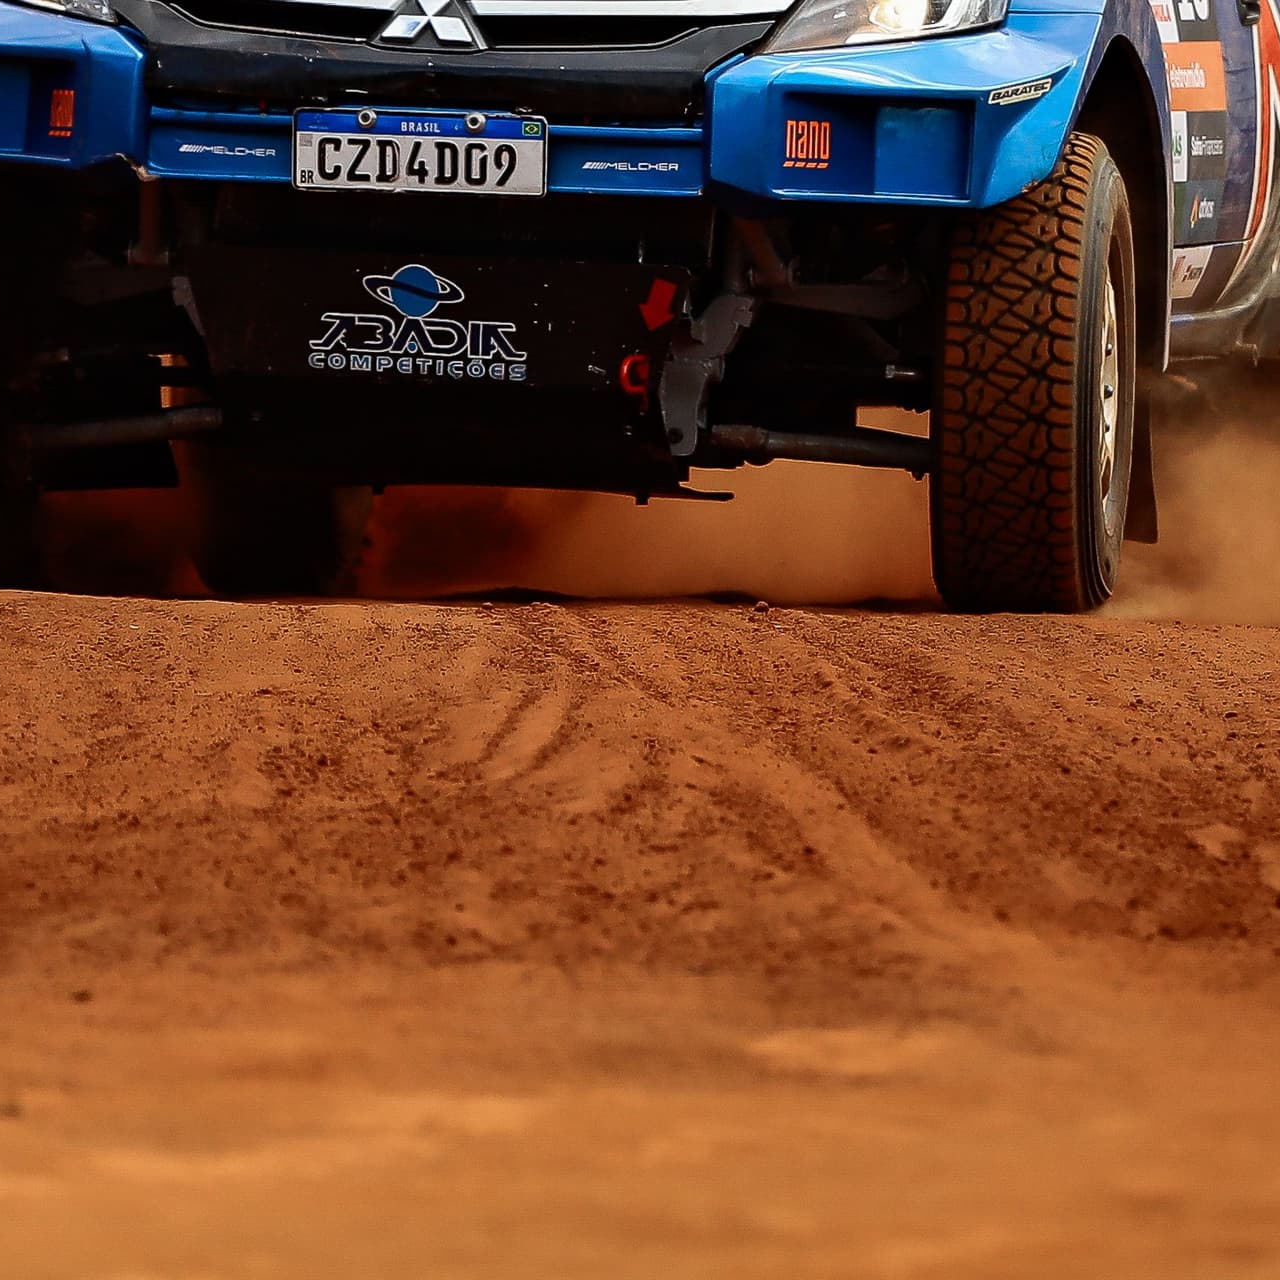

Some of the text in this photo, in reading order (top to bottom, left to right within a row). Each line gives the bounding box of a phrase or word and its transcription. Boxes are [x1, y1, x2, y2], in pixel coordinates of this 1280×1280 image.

[990, 81, 1050, 103] BARATEC
[400, 121, 441, 133] BRASIL
[785, 119, 832, 160] nano
[202, 146, 276, 157] MELCHER
[317, 135, 518, 188] CZD4D09
[299, 169, 314, 185] BR
[309, 312, 528, 361] ABADIA
[308, 352, 527, 381] COMPETIÇÕES
